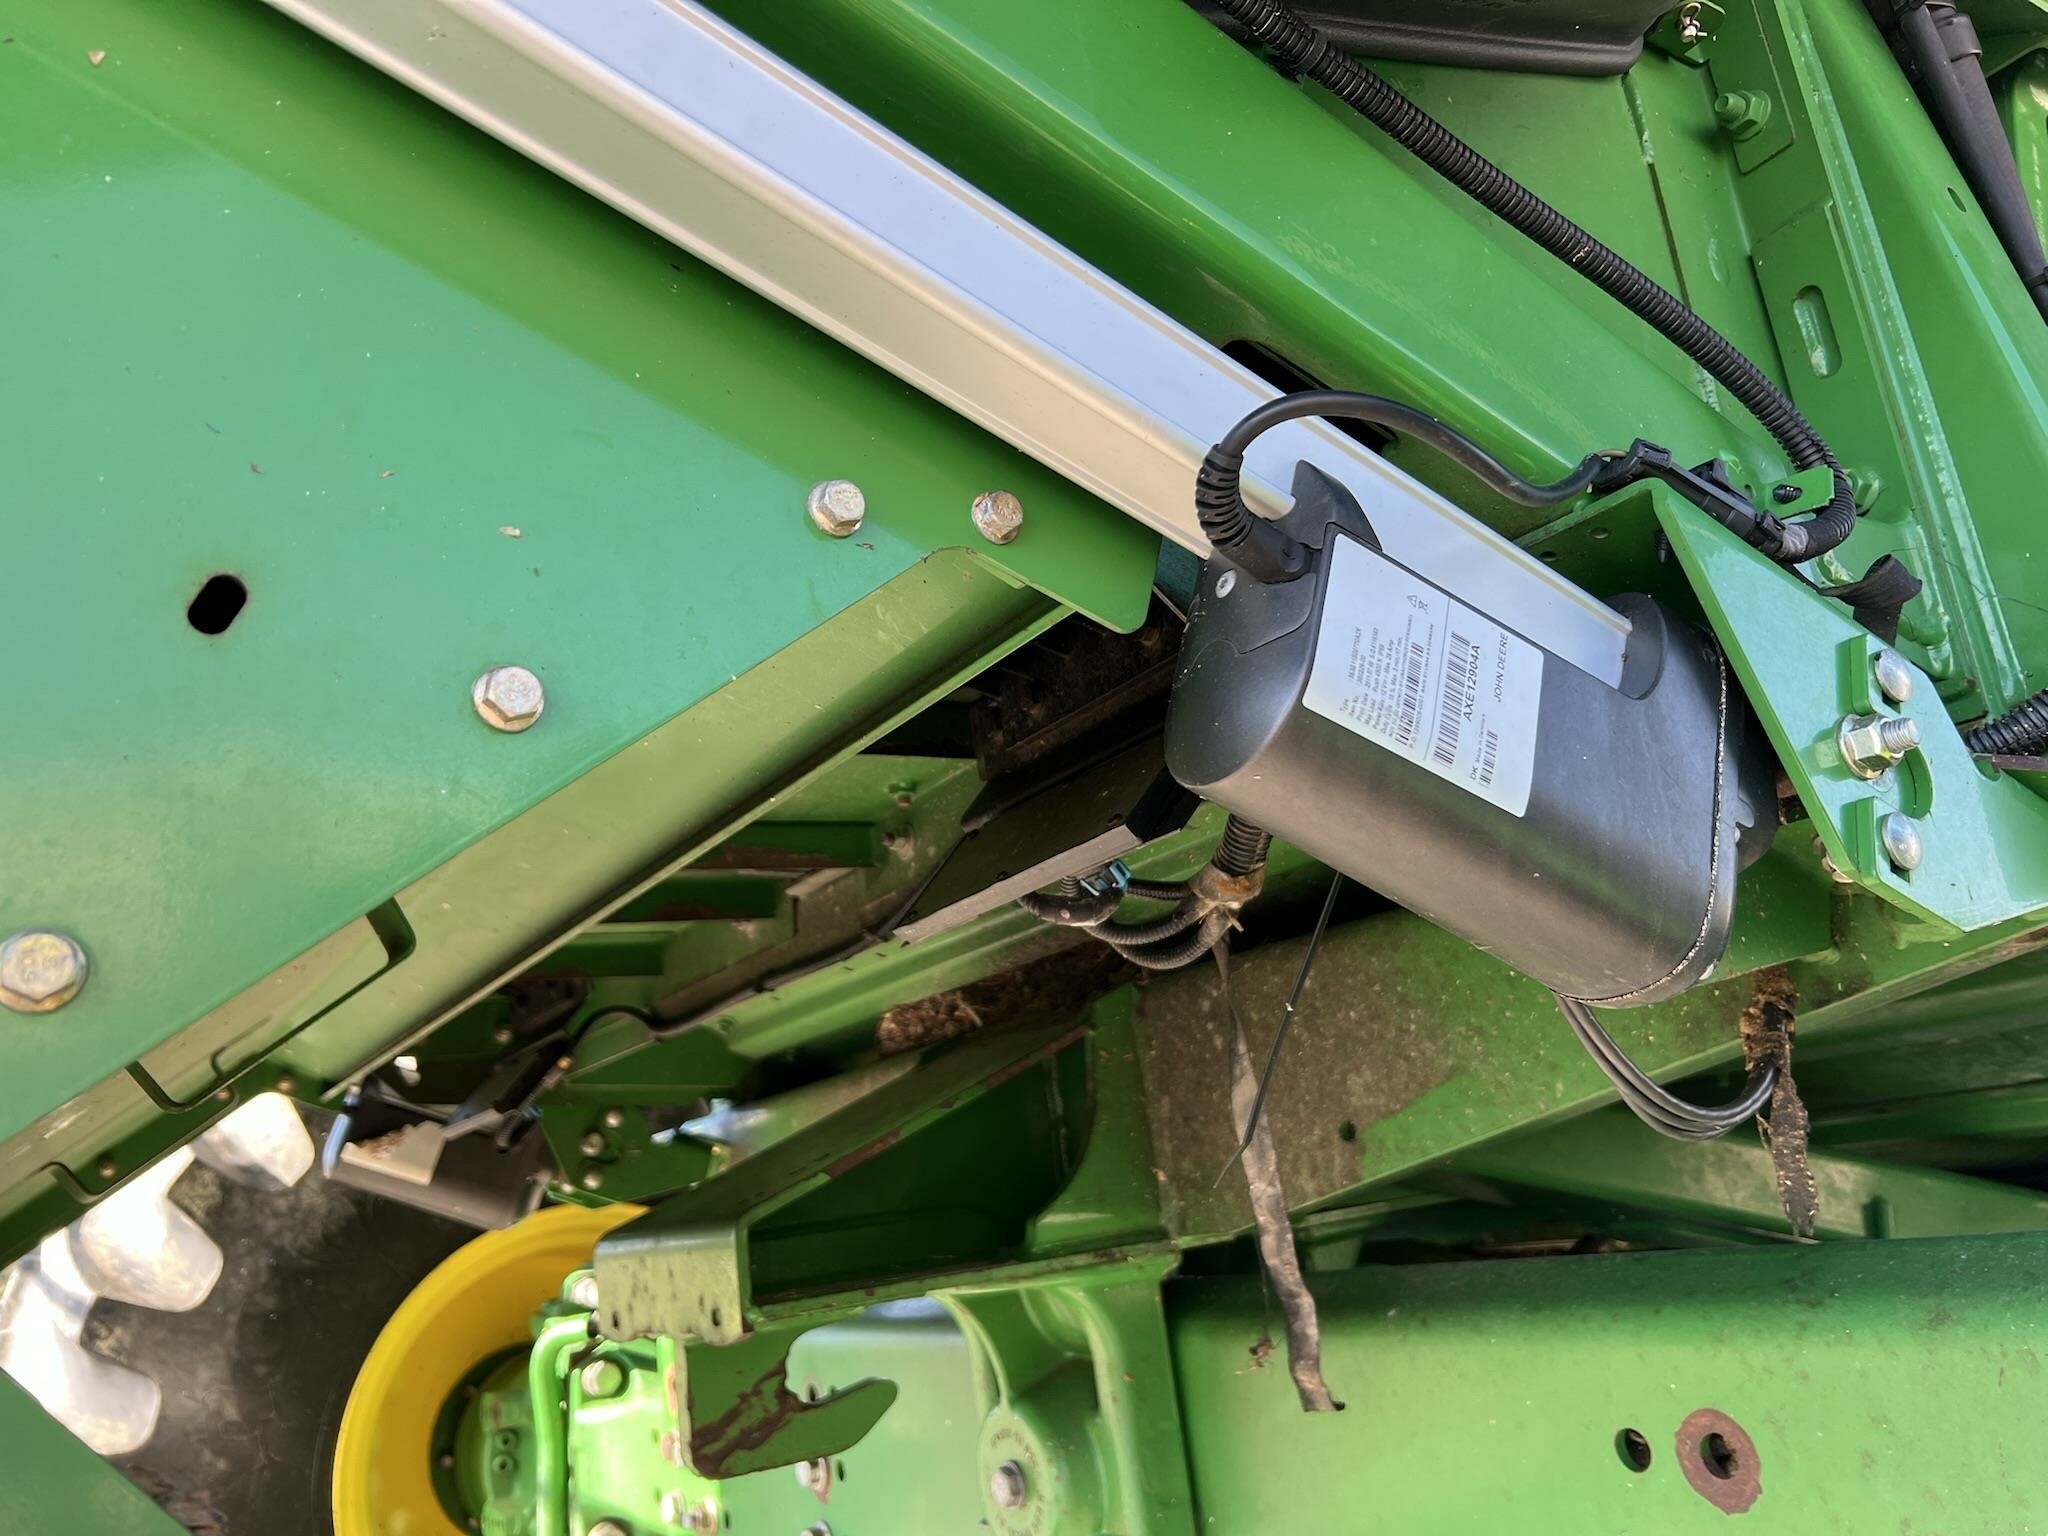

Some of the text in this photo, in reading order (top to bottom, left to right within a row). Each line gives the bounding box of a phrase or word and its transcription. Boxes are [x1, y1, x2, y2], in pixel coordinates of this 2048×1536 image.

[1463, 644, 1481, 721] AXE12904A
[1493, 632, 1508, 703] JOHN DEERE
